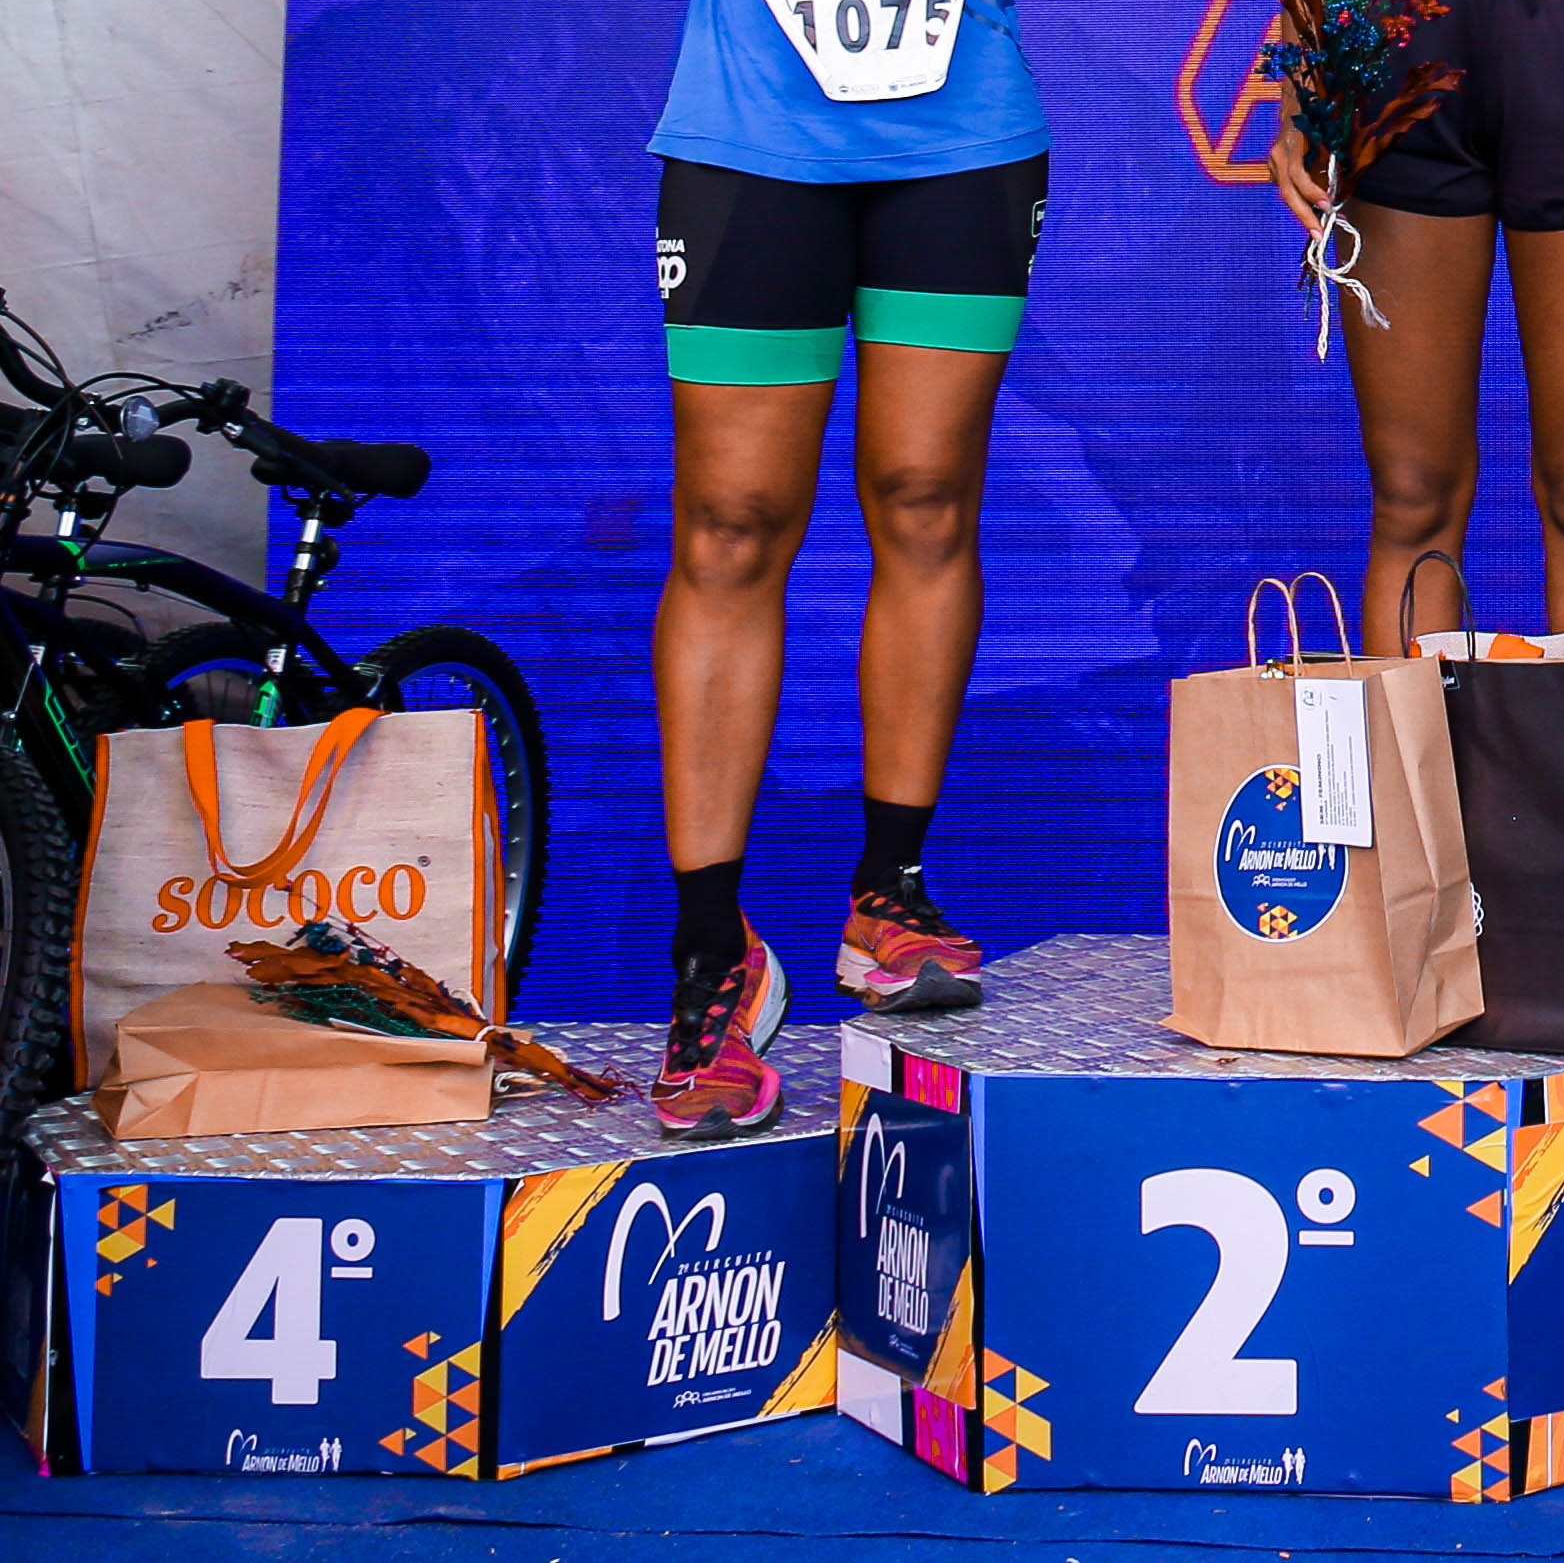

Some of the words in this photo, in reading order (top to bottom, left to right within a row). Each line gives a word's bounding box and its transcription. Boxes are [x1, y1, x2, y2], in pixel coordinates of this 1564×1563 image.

[1239, 848, 1274, 870] ARNON
[1274, 851, 1284, 868] DE
[1283, 847, 1317, 870] MELLO
[693, 1250, 772, 1272] CIRCUITO
[876, 1216, 929, 1290] ARNON
[200, 1217, 377, 1406] 4º
[647, 1261, 786, 1340] ARNON
[878, 1273, 894, 1321] DE
[893, 1278, 929, 1335] MELLO
[1133, 1166, 1357, 1417] 2º
[647, 1335, 691, 1387] DE
[688, 1319, 782, 1379] MELLO
[241, 1454, 278, 1472] ARNON
[287, 1454, 320, 1472] MELLO
[1200, 1463, 1239, 1484] ARNON
[1238, 1467, 1249, 1483] DE
[1248, 1464, 1283, 1485] MELLO
